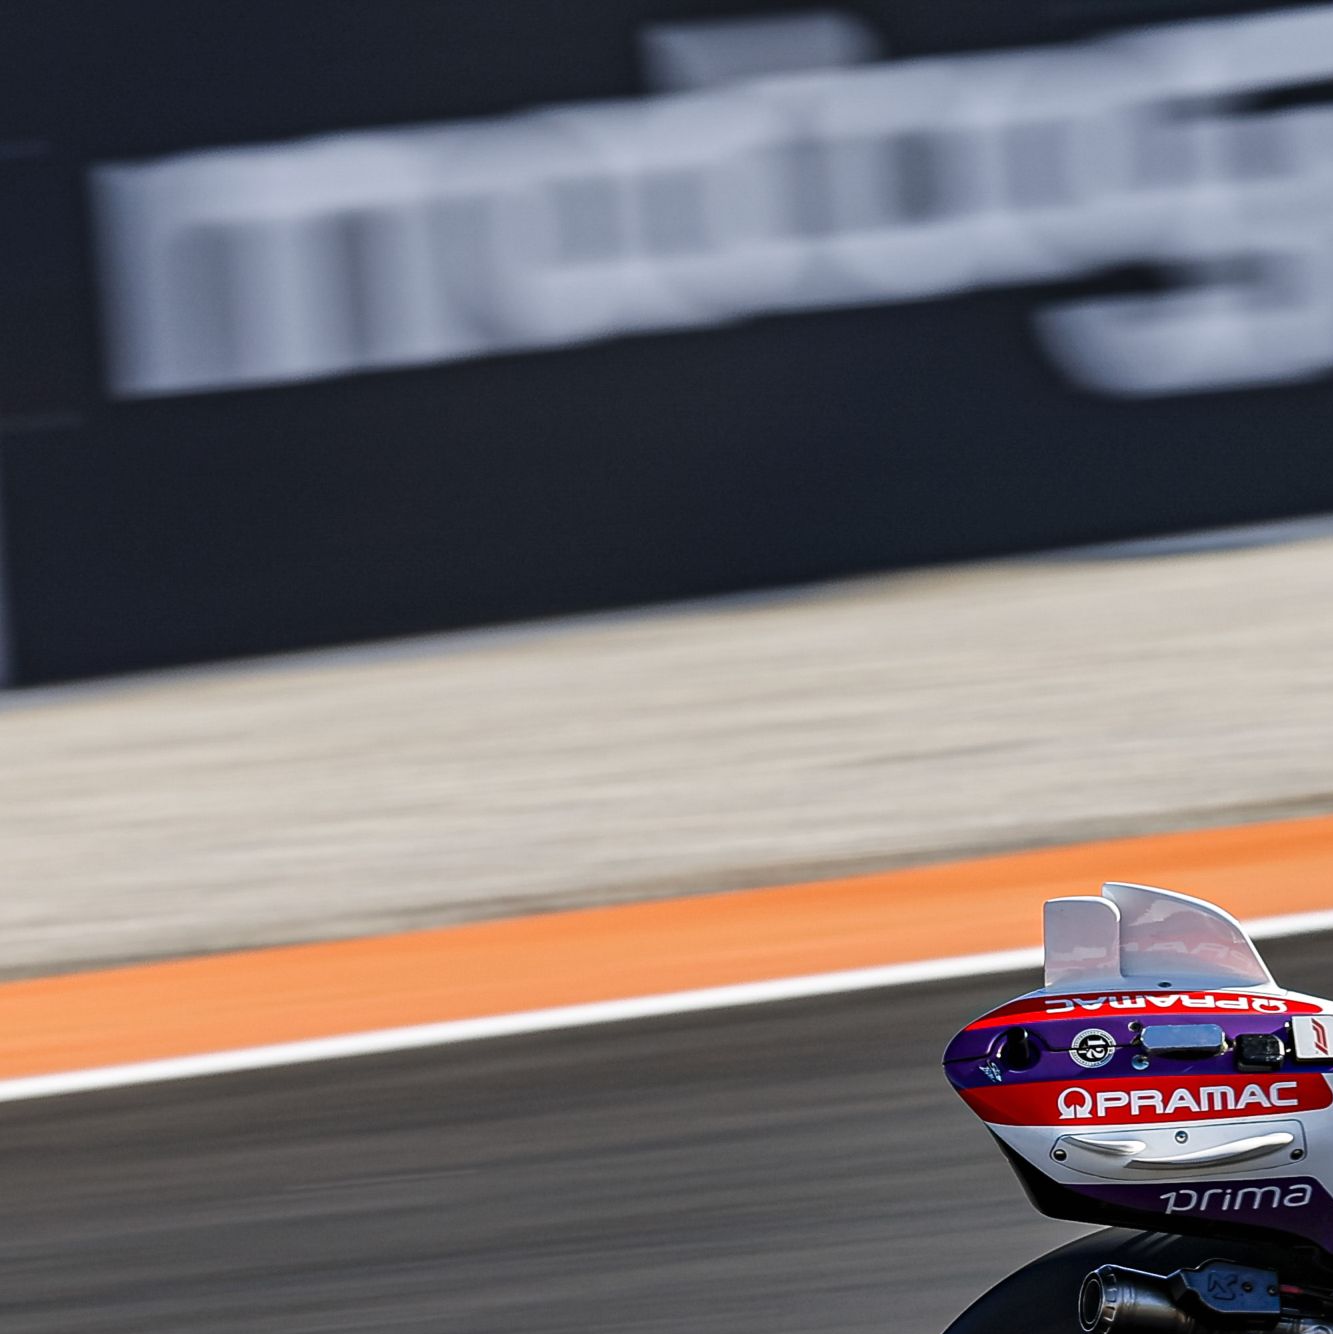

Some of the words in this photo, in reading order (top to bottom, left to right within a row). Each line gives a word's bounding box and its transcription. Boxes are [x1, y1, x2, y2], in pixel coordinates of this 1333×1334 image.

[1044, 992, 1250, 1016] PRAMAC
[1097, 1080, 1300, 1117] PRAMAC
[1159, 1181, 1315, 1215] prima
